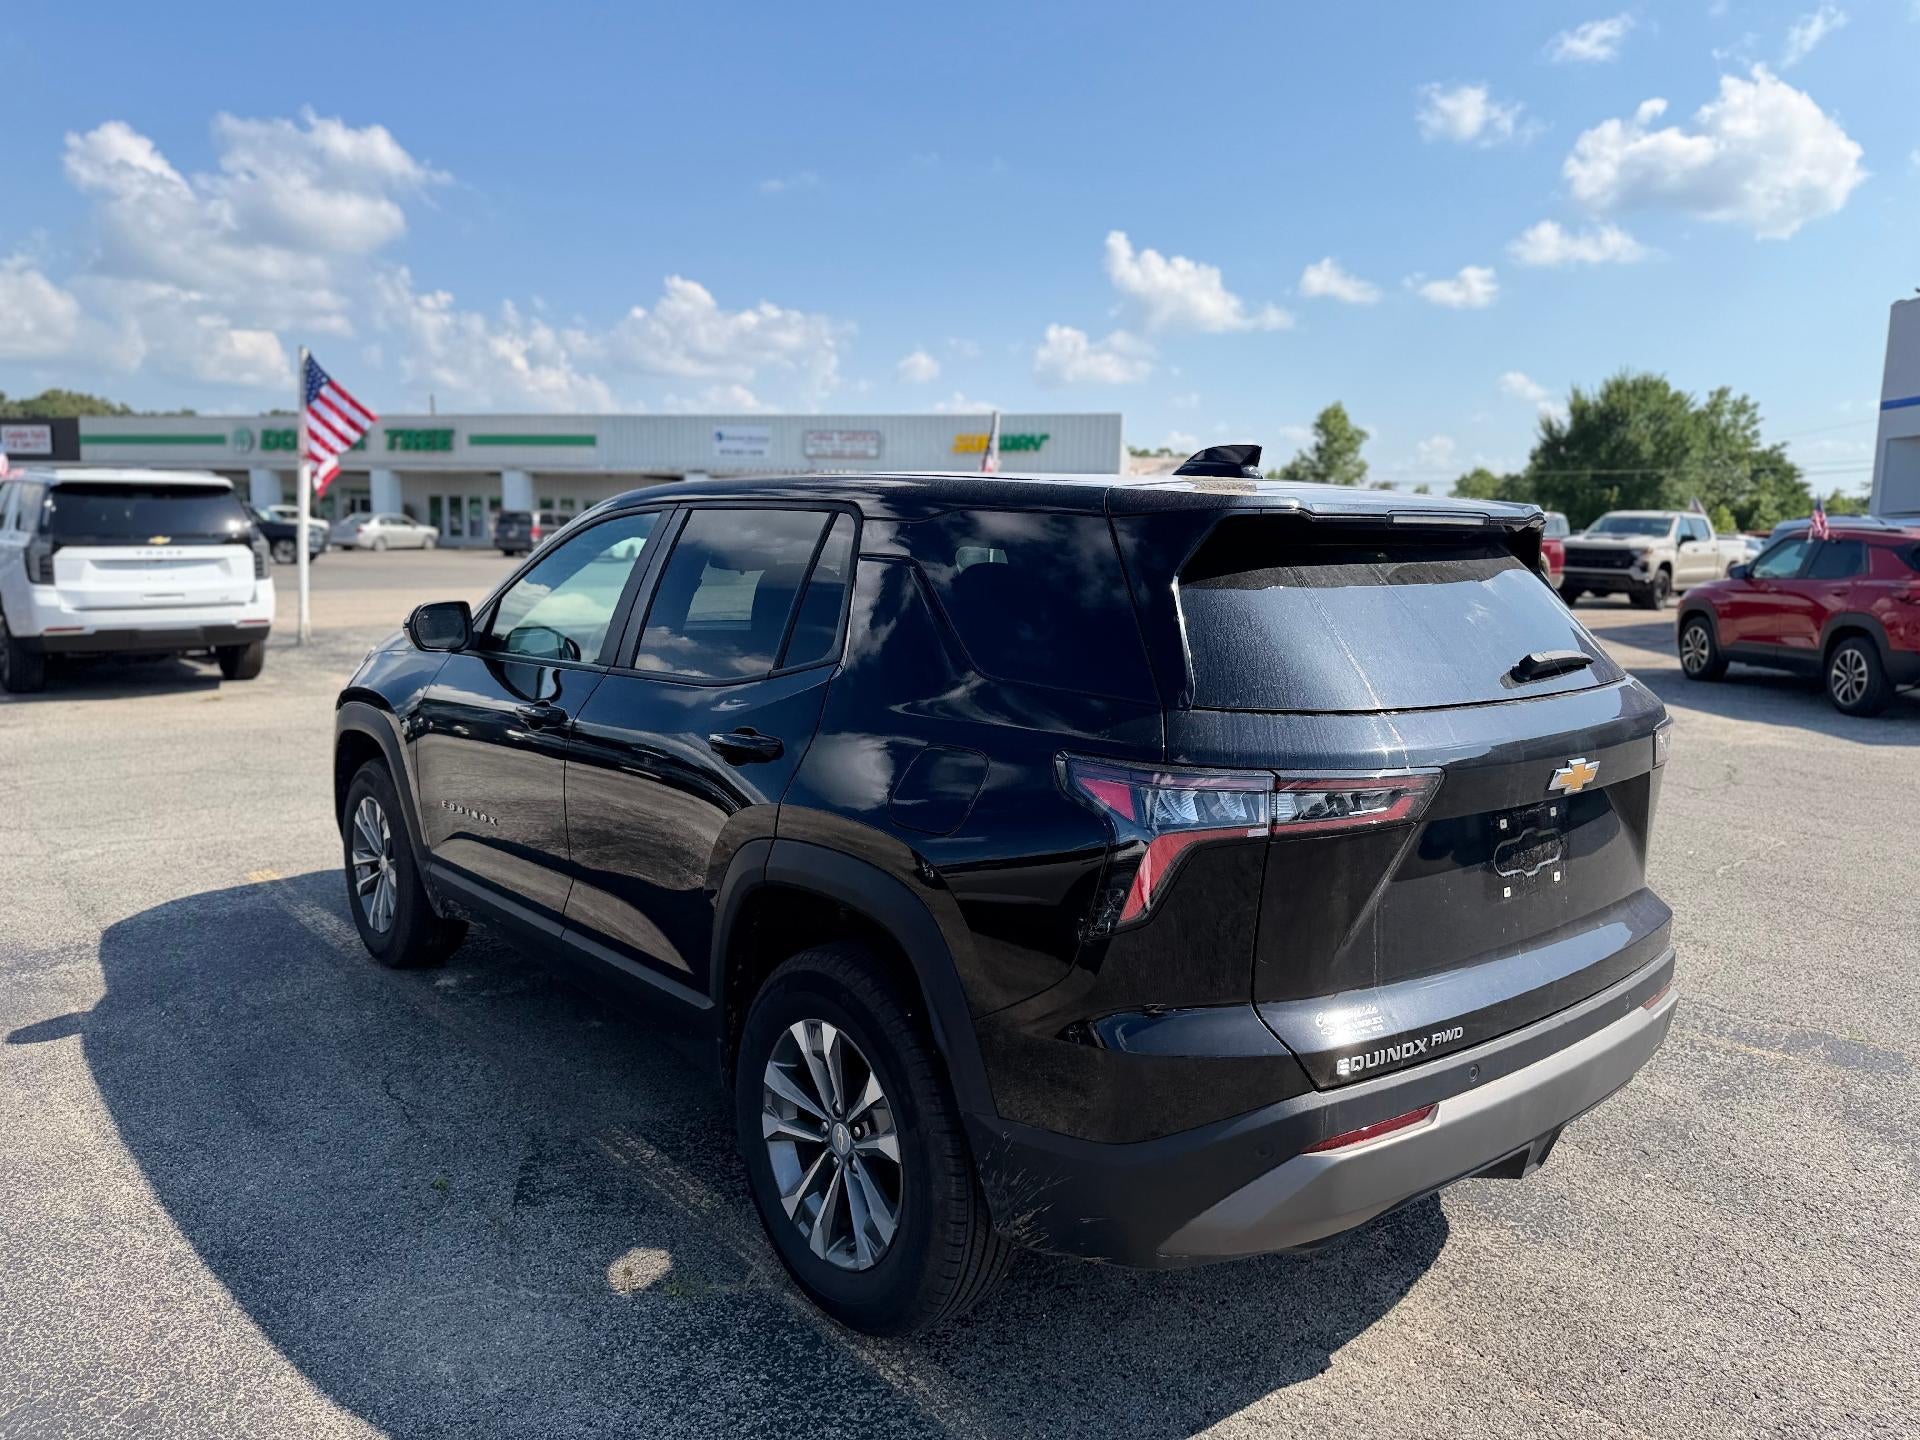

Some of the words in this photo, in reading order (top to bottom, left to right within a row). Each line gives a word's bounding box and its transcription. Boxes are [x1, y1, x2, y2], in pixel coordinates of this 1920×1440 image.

[384, 428, 455, 451] TREE
[441, 799, 498, 826] EQUINOX
[1336, 1037, 1428, 1076] EQUINOX
[1431, 1026, 1464, 1046] AWD
